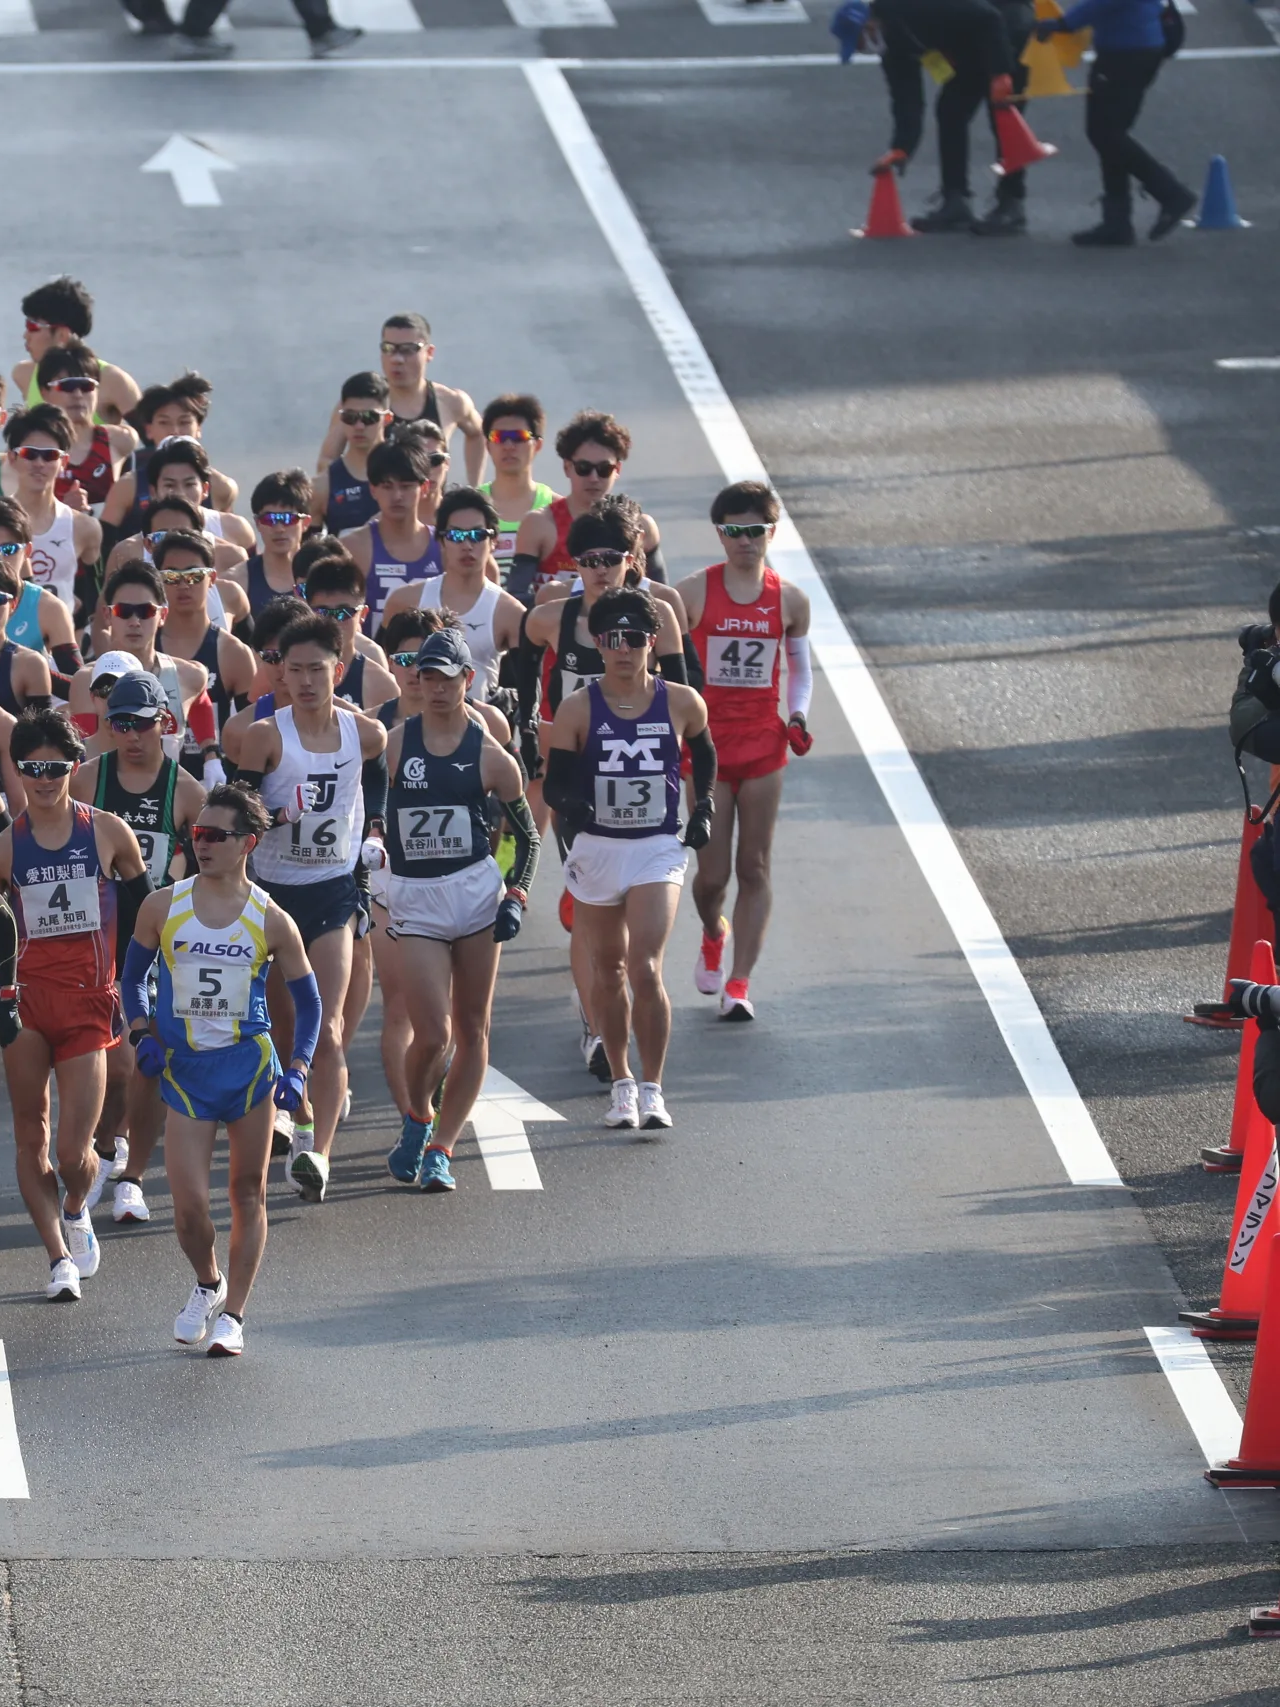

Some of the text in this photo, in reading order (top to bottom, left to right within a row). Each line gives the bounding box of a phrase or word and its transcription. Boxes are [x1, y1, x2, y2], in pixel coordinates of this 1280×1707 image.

[716, 618, 769, 634] JR九州
[720, 640, 765, 667] 42
[598, 738, 664, 772] M
[402, 781, 428, 789] TOKYO
[607, 779, 652, 807] 13
[292, 818, 337, 846] 16
[409, 809, 455, 838] 27
[291, 845, 337, 858] 石田 理人
[405, 838, 437, 850] 長谷川
[26, 863, 87, 884] 愛知製鋼
[48, 883, 72, 912] 4
[37, 914, 60, 928] 丸尾
[63, 910, 87, 924] 知司
[189, 941, 253, 958] ALSOK
[198, 968, 223, 997] 5
